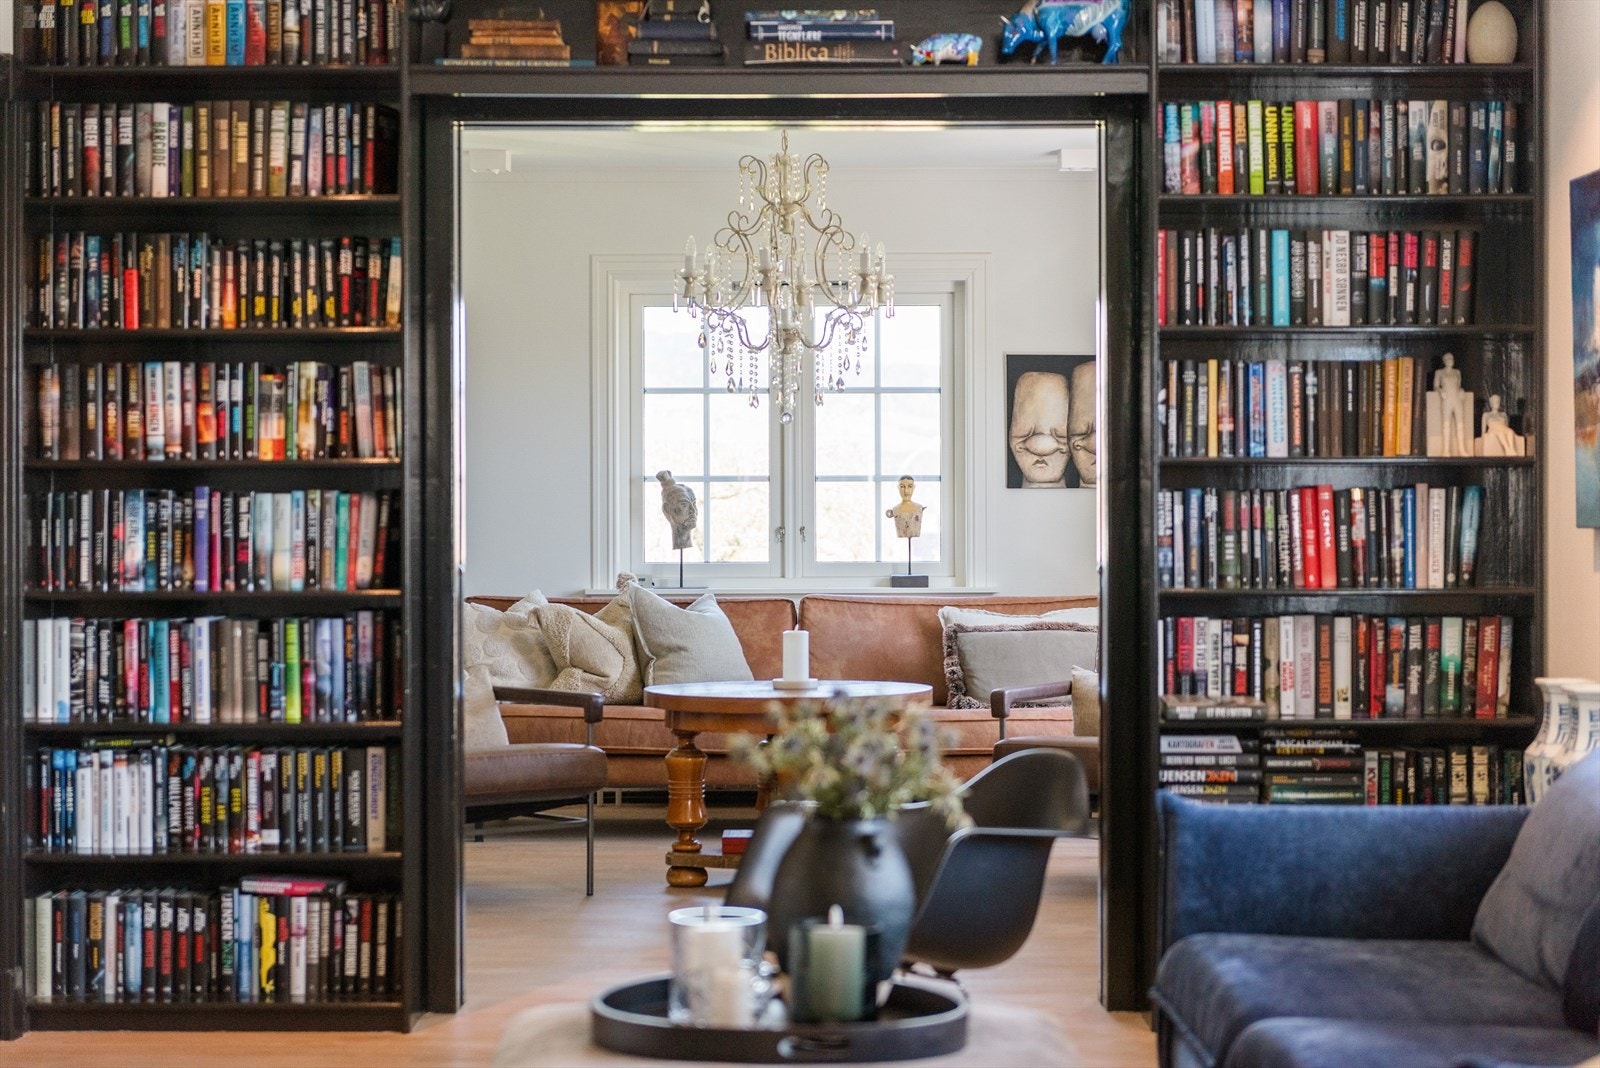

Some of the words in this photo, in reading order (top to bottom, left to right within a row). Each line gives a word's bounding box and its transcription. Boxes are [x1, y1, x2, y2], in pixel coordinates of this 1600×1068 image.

[765, 43, 829, 61] Biblica
[1265, 107, 1278, 142] UNNI
[1282, 106, 1294, 142] UNNI
[1384, 105, 1392, 120] LIZA
[84, 118, 98, 146] UGLEN
[119, 117, 132, 145] ULVEN
[152, 122, 166, 167] BARCODE
[1384, 121, 1393, 158] MARKLUND
[271, 132, 285, 166] BROWN
[1220, 131, 1232, 172] LINDELL
[1250, 131, 1261, 172] LINDELL
[1268, 143, 1277, 179] LINDELL
[1285, 143, 1293, 178] LINDELL
[1506, 140, 1515, 162] JAKTEN
[1336, 234, 1346, 244] JO
[1442, 239, 1450, 248] JO
[1442, 249, 1450, 270] NESBØ
[1336, 277, 1346, 311] SØNNEN
[1293, 374, 1301, 405] SATANS
[1293, 407, 1301, 446] SOMMER
[1196, 621, 1207, 646] CHRIS
[1211, 633, 1219, 662] CHRIS
[1409, 624, 1421, 649] WIIK
[1484, 625, 1495, 652] WIIK
[1211, 665, 1219, 691] TVEDT
[1301, 653, 1312, 699] DRONNINGEN
[1168, 739, 1214, 749] KARTOGRAFEN
[1452, 752, 1467, 763] JO
[1474, 752, 1488, 764] JO
[1162, 770, 1205, 782] JENSEN
[169, 777, 181, 832] NULLPUNKT
[221, 896, 232, 940] JENSEN
